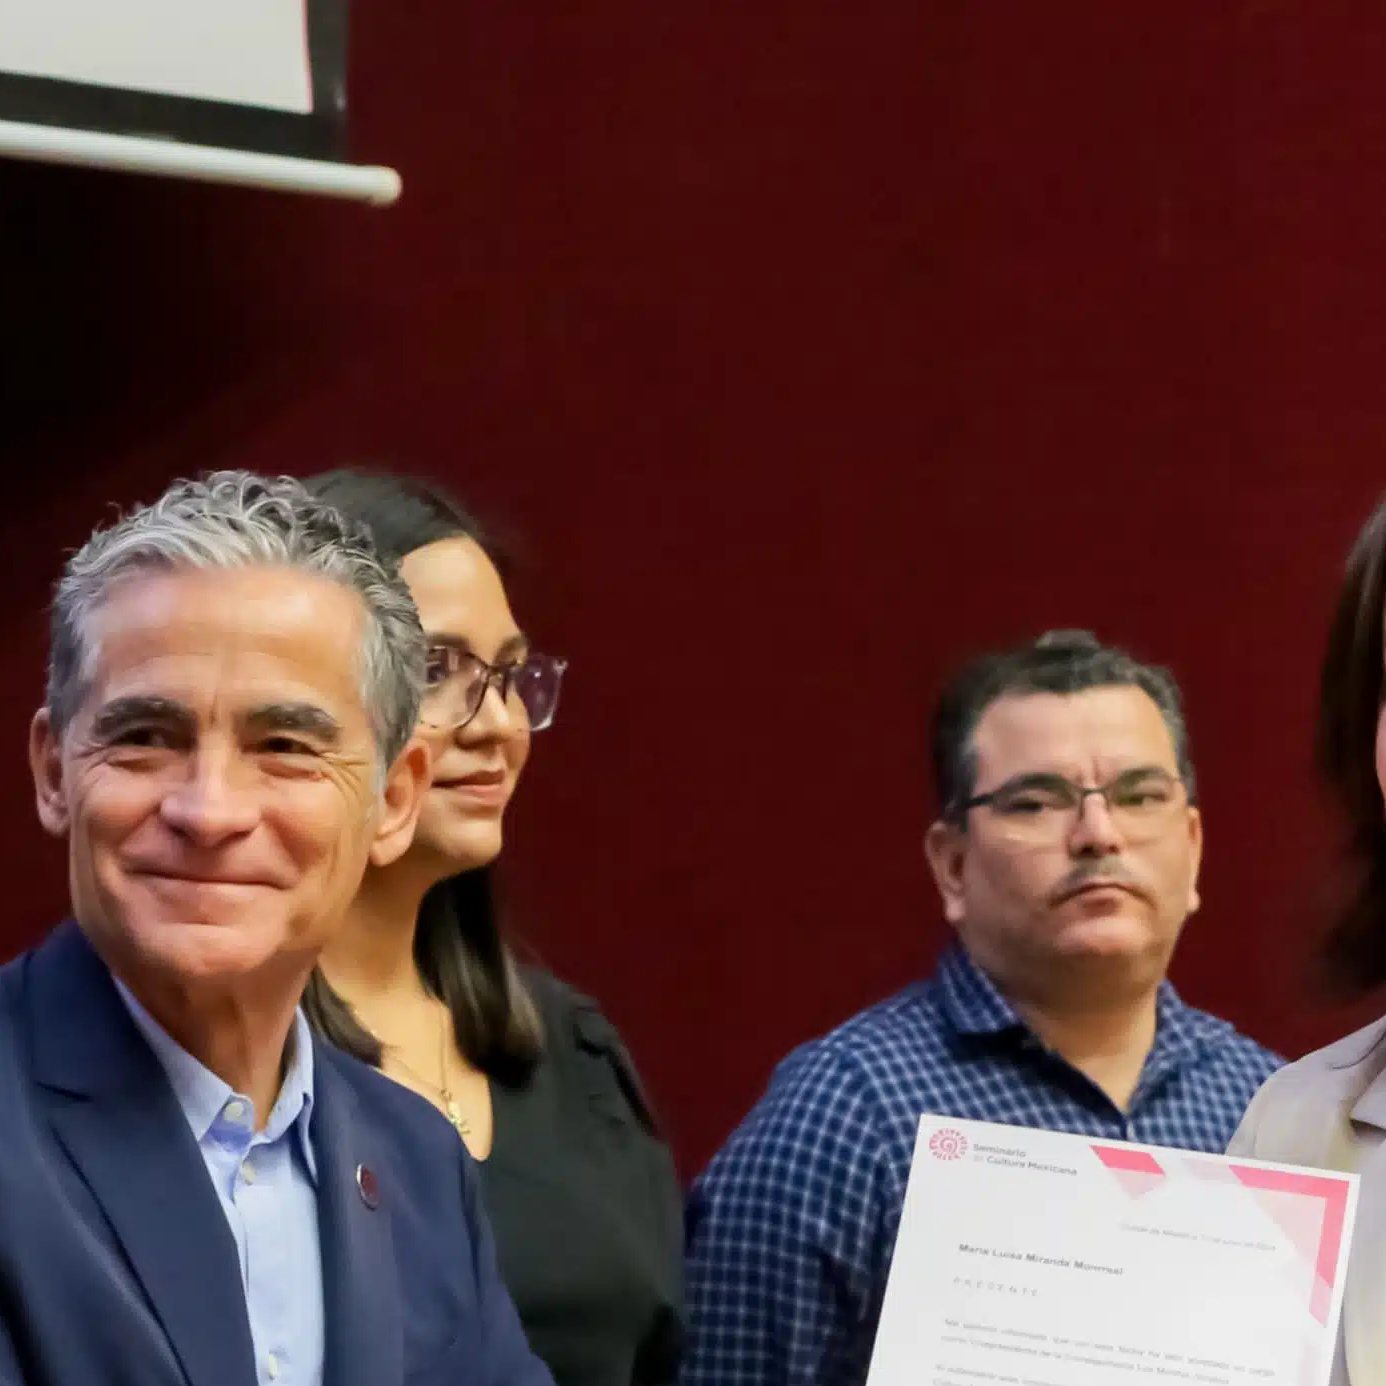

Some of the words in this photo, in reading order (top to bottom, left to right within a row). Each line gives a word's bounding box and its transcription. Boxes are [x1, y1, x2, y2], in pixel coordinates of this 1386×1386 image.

[973, 1143, 1027, 1158] Seminario
[986, 1155, 1026, 1169] Cultura
[1027, 1161, 1078, 1177] Mexicana
